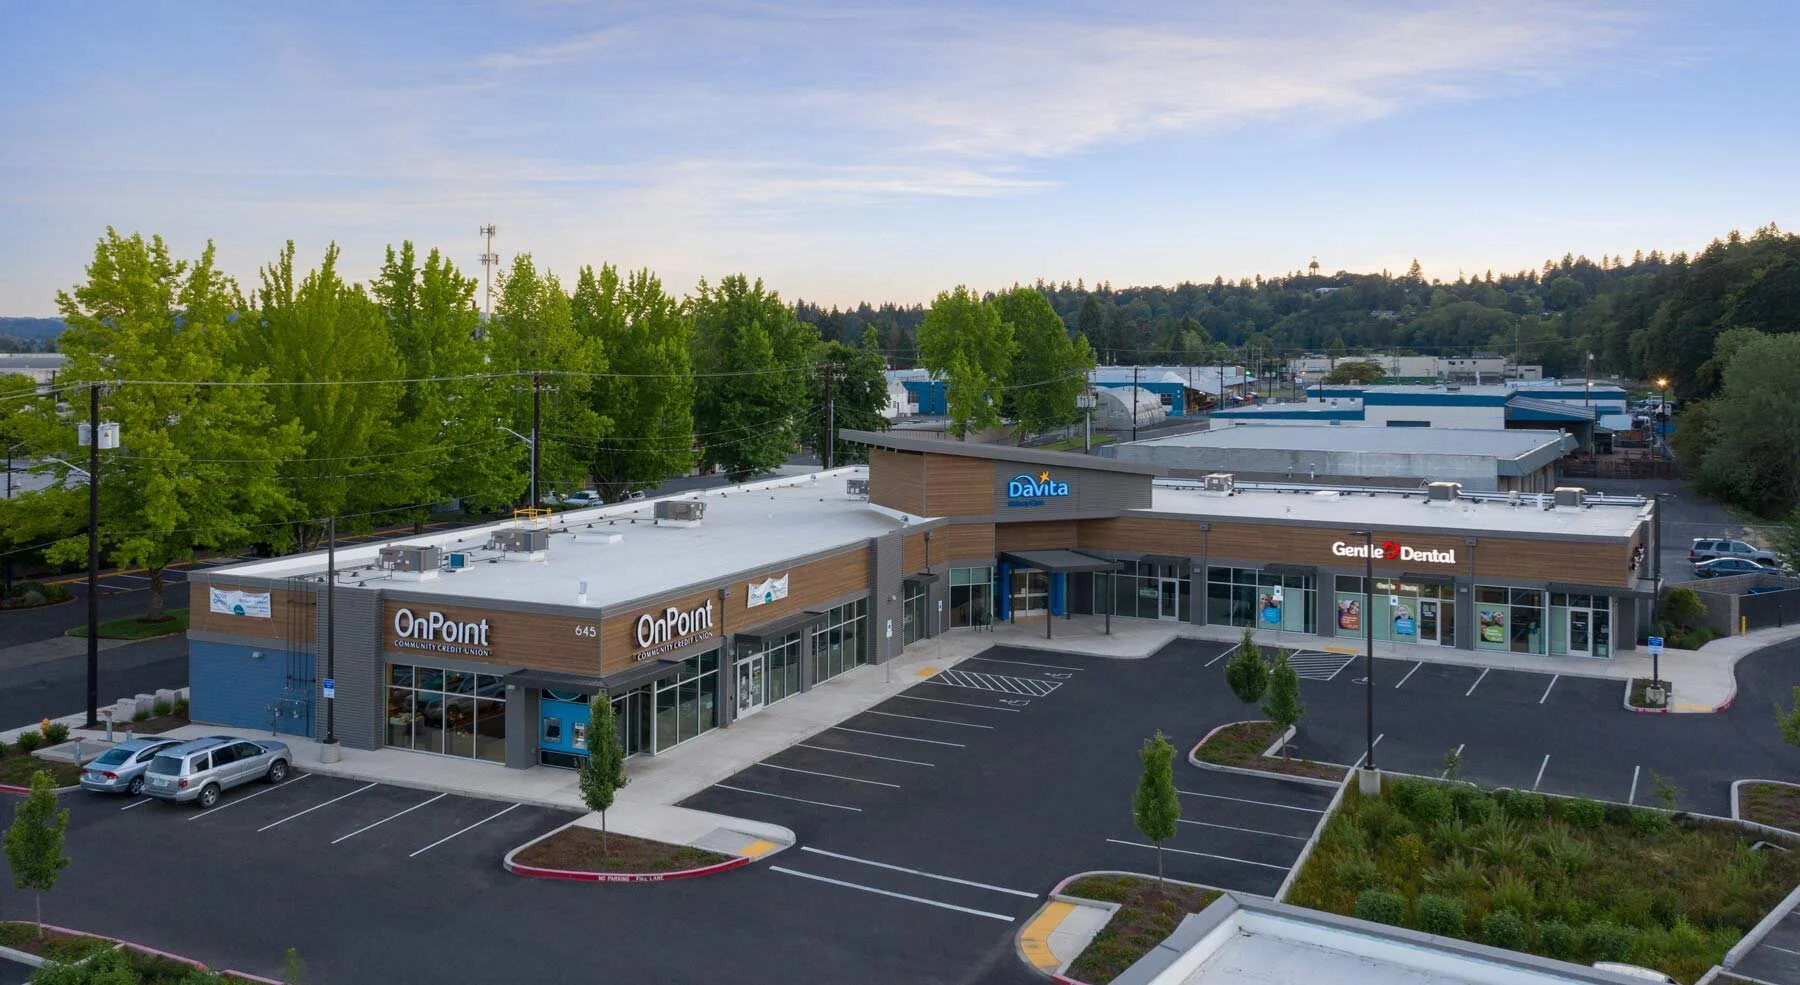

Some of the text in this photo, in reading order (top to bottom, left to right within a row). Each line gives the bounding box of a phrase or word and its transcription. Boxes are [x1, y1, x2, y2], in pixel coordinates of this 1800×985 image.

[1009, 474, 1069, 498] DaVita
[1332, 541, 1456, 564] Gentle Dental
[394, 608, 489, 646] OnPoint
[575, 625, 597, 637] 645
[637, 598, 713, 648] OnPoint
[394, 639, 488, 656] COMMUNITY CREDIT UNION
[637, 631, 713, 661] COMMUNITY CREDIT UNION
